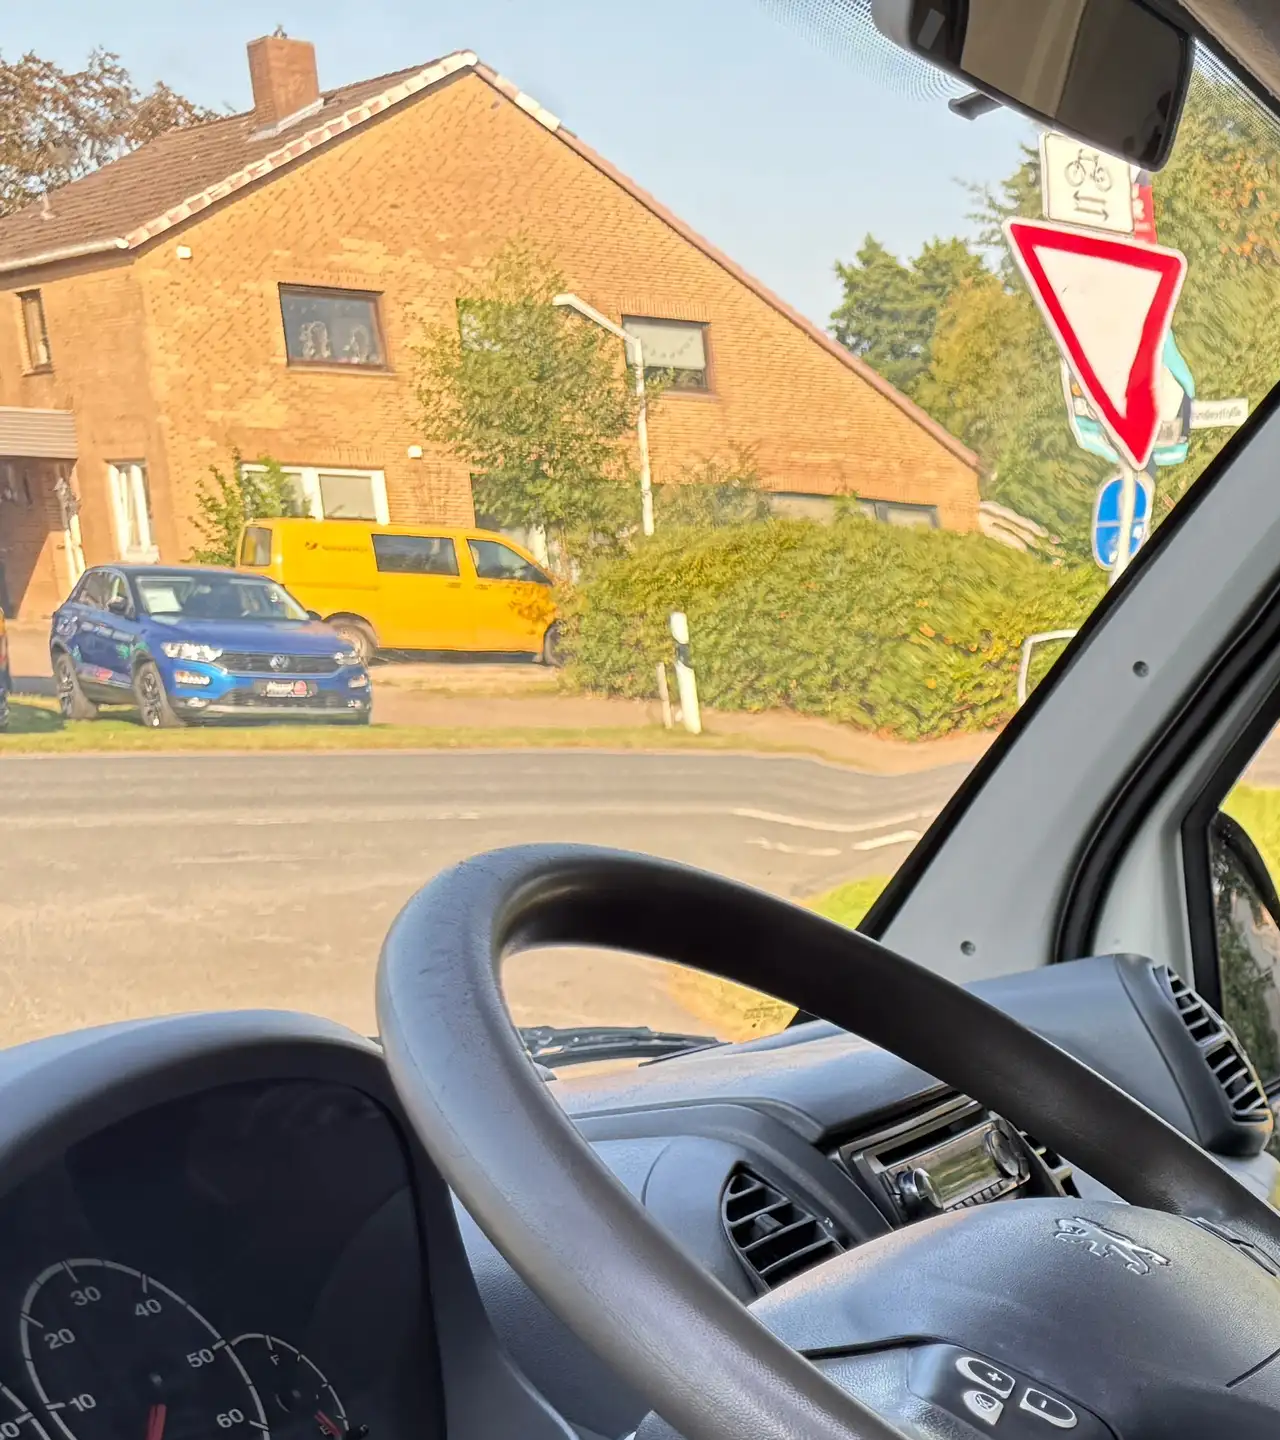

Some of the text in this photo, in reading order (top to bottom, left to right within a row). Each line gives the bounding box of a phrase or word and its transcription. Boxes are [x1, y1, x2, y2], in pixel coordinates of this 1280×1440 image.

[71, 1286, 101, 1306] 30
[134, 1299, 162, 1317] 40
[44, 1328, 76, 1349] 20
[186, 1348, 215, 1368] 50
[270, 1354, 280, 1366] F
[69, 1393, 97, 1412] 10
[216, 1408, 244, 1428] 60
